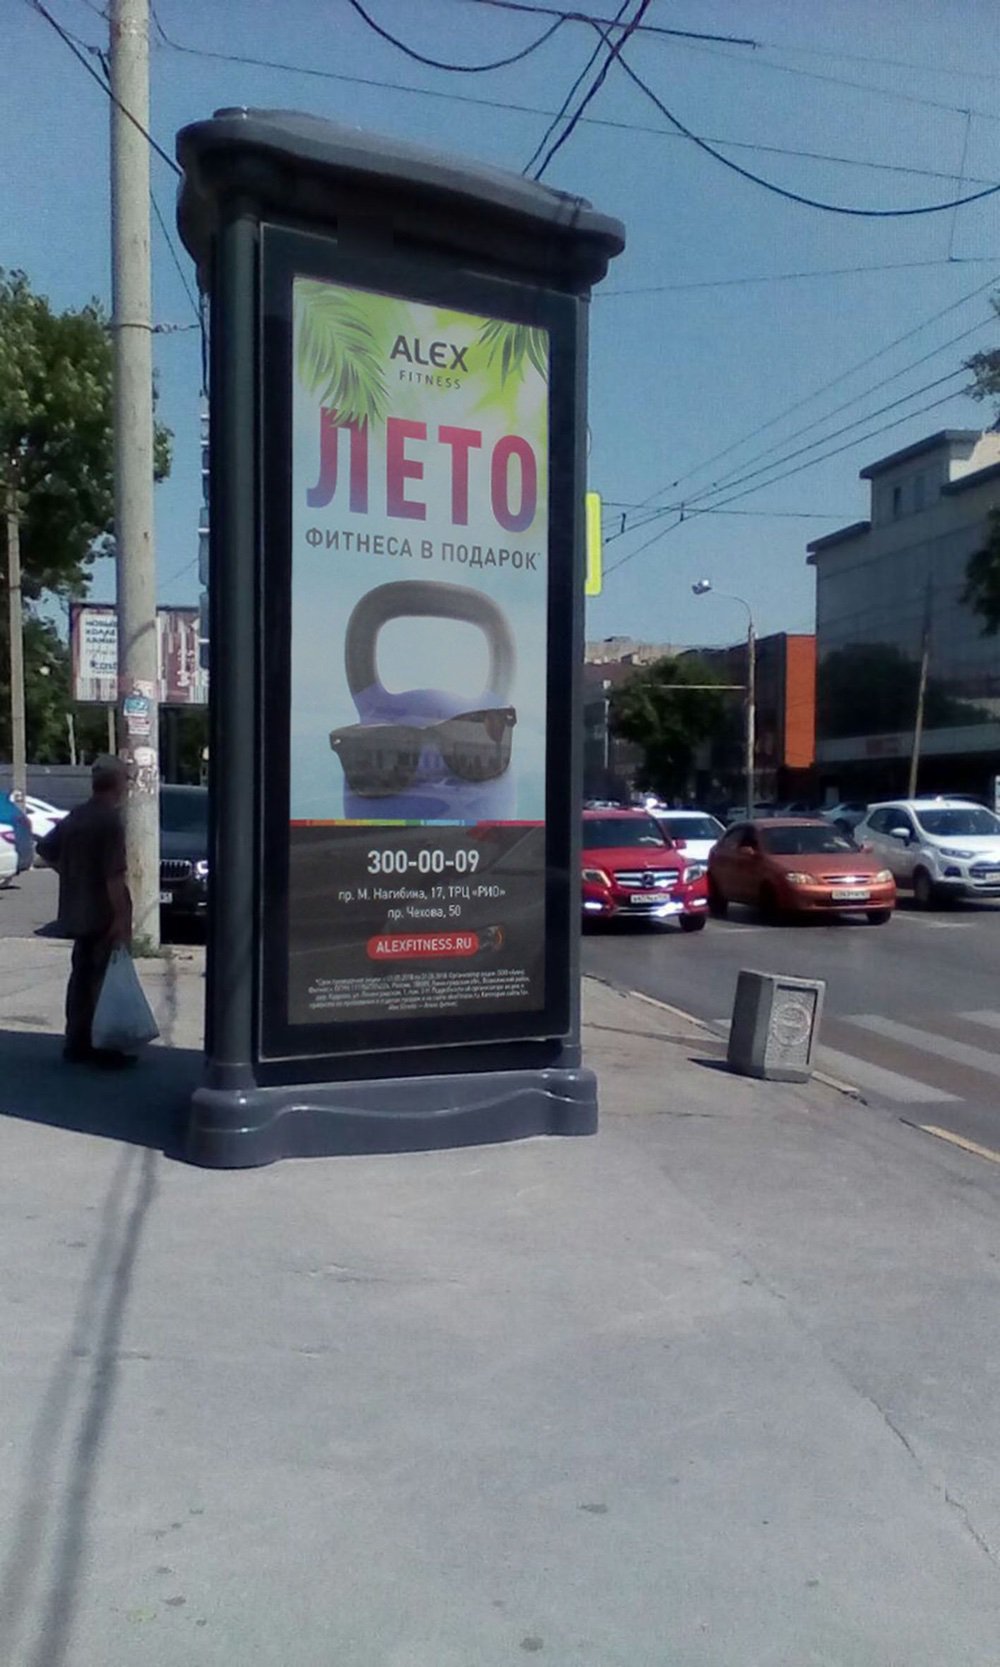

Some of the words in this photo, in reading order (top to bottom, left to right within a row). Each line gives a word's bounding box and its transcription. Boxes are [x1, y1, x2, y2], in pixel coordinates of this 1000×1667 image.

[390, 335, 469, 373] ALEX
[399, 369, 461, 390] FITNESS
[306, 406, 538, 533] ЛЕТО
[305, 527, 412, 557] ФИТНЕСА
[421, 540, 434, 559] В
[367, 850, 480, 874] 300-00-09
[338, 891, 354, 903] пр.
[357, 889, 371, 900] М.
[373, 886, 428, 901] Нагибина,
[431, 887, 446, 900] 17,
[449, 886, 470, 900] ТРЦ
[387, 908, 404, 921] пр.
[406, 905, 446, 919] Чехова,
[449, 904, 461, 917] 50
[376, 937, 472, 953] ALEXFITNESS.RU
